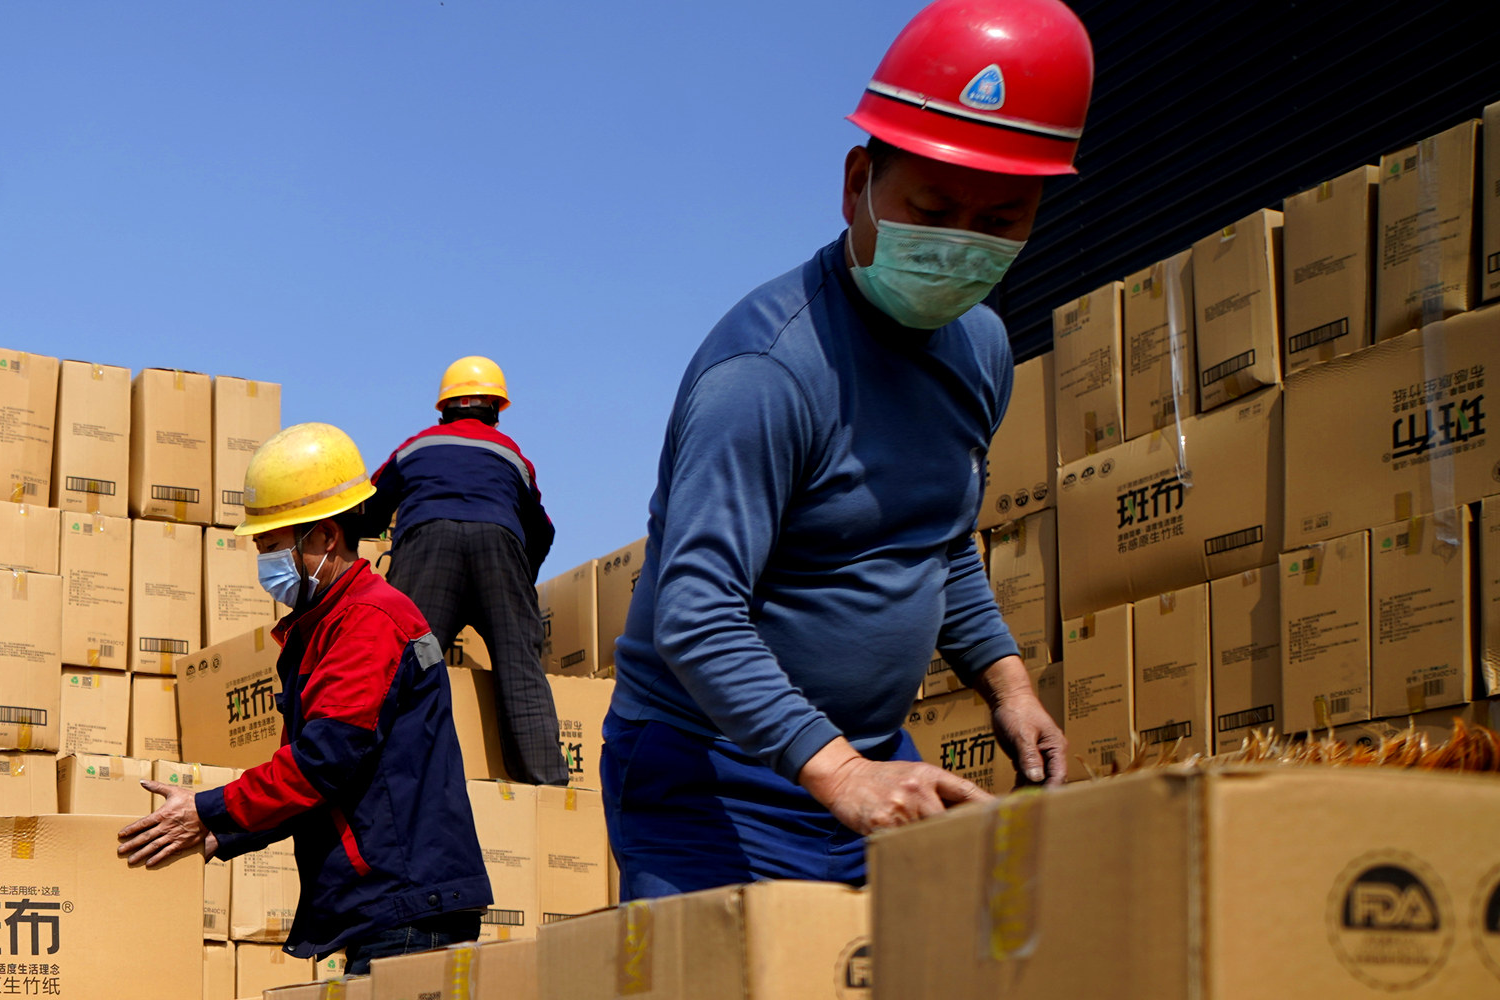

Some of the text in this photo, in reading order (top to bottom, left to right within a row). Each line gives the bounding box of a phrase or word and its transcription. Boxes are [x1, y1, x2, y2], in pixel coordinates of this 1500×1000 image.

[1116, 476, 1184, 529] 斑布
[226, 677, 275, 725] 斑布
[940, 732, 996, 772] 斑布
[1353, 881, 1435, 928] FDA
